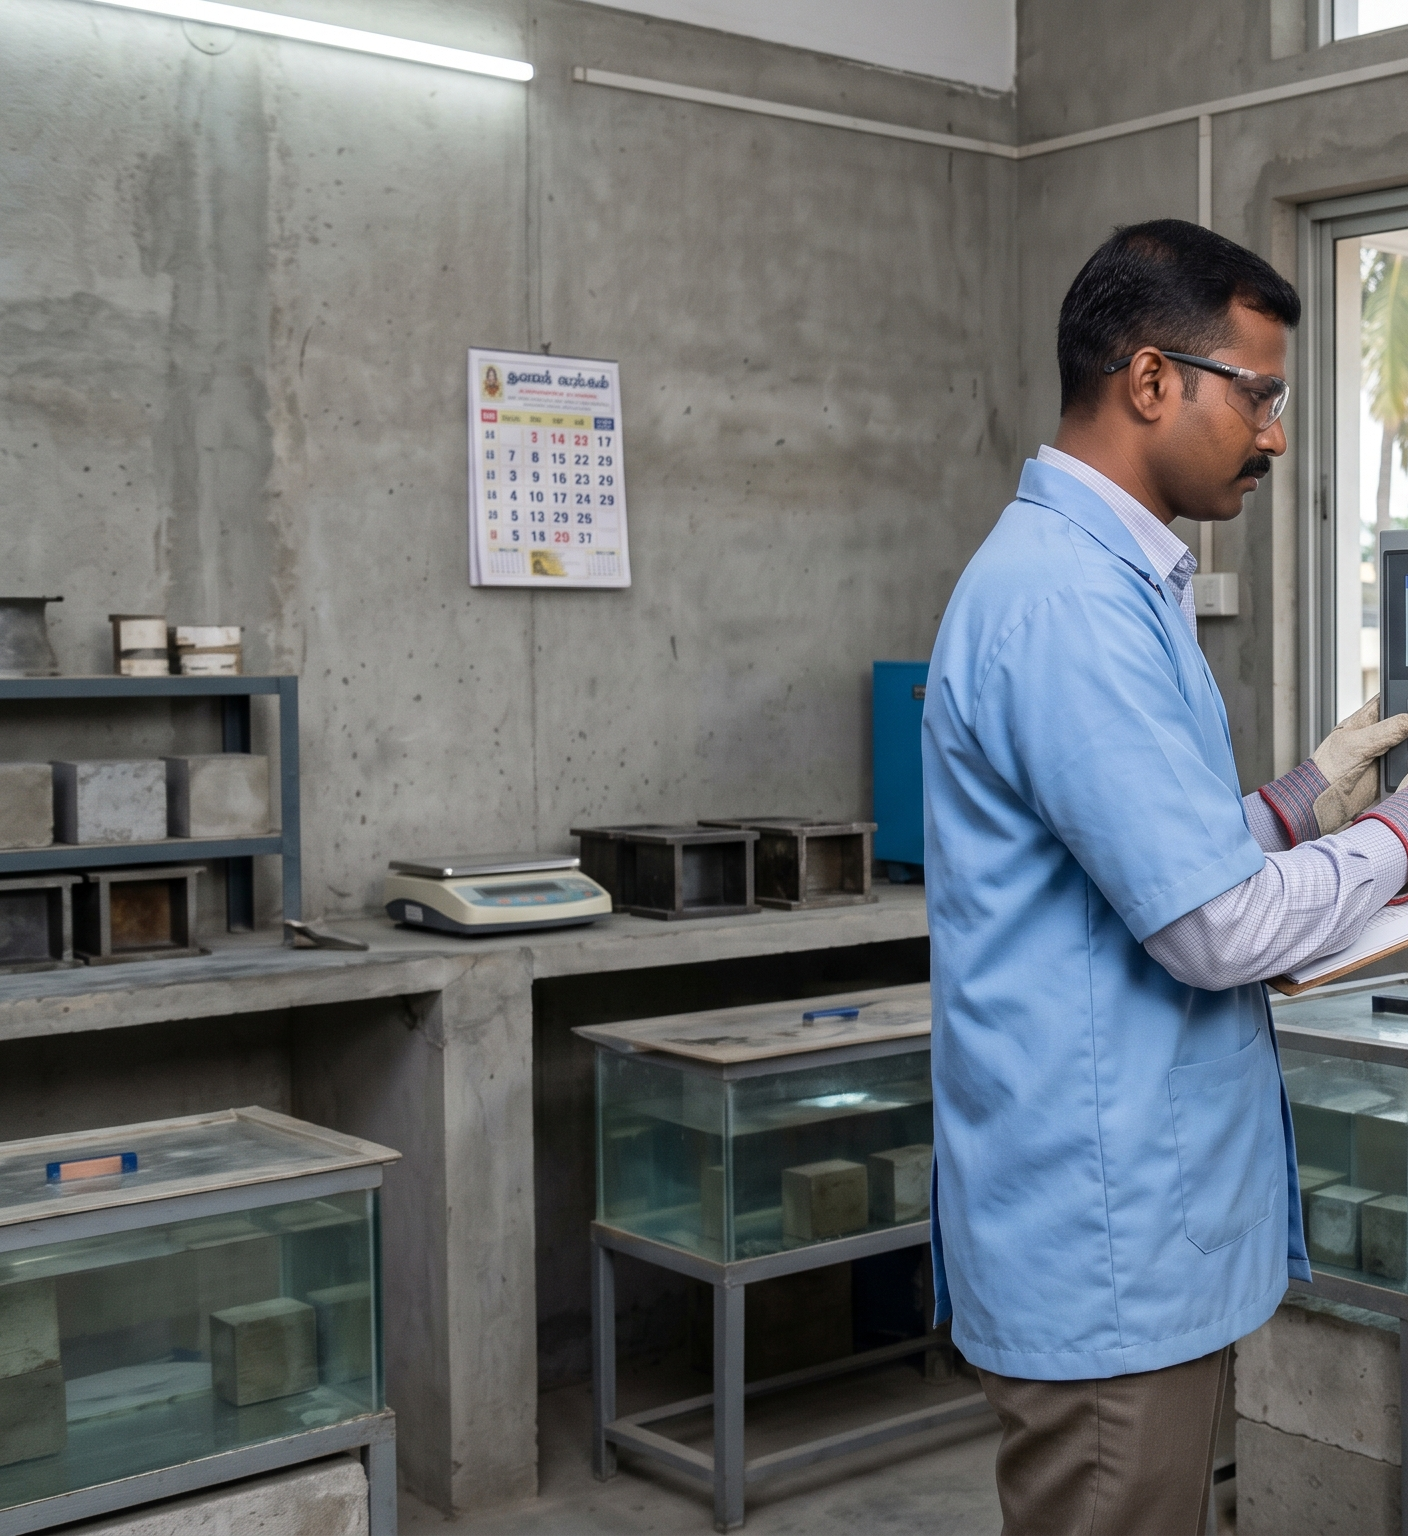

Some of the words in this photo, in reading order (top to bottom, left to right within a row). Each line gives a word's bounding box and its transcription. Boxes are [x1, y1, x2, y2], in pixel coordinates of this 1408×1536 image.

[530, 431, 538, 444] 3
[550, 432, 566, 445] 14
[574, 434, 589, 447] 23
[597, 435, 612, 448] 17
[508, 449, 516, 462] 7
[531, 451, 540, 463] 8
[551, 452, 567, 465] 15
[574, 453, 589, 466] 22
[597, 455, 613, 467] 29
[509, 469, 518, 482] 3
[531, 471, 540, 483] 9
[552, 472, 567, 485] 16
[574, 473, 591, 486] 23
[598, 474, 614, 487] 29
[510, 490, 518, 501] 4
[529, 490, 544, 503] 10
[553, 492, 567, 504] 17
[575, 493, 591, 505] 24
[599, 494, 615, 506] 29
[511, 509, 519, 522] 5
[553, 511, 569, 524] 29
[511, 529, 520, 542] 5
[554, 531, 570, 544] 29
